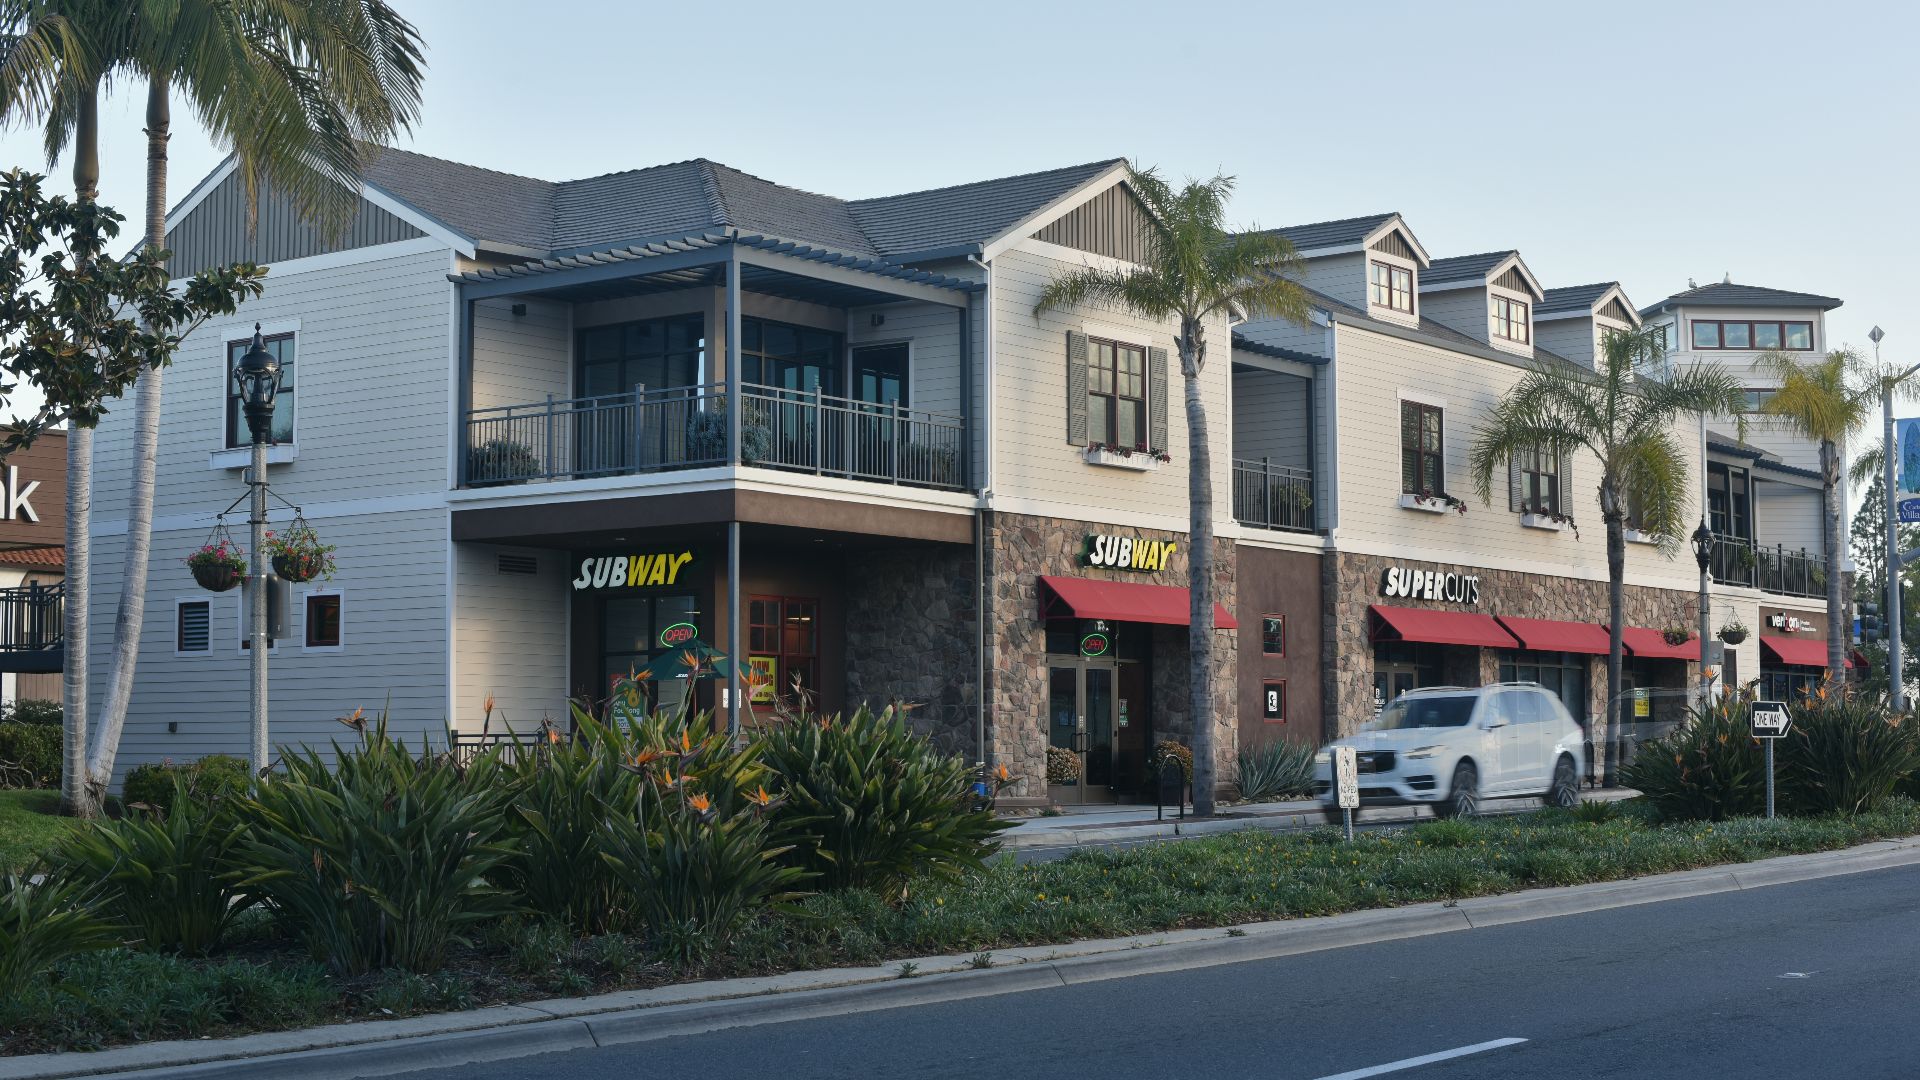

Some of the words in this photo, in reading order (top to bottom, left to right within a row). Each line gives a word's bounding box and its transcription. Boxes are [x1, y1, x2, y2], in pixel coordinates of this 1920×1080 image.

[1089, 535, 1177, 571] SUBWAY
[573, 550, 693, 591] SUBWAY
[1385, 567, 1479, 604] SUPERCUTS
[666, 629, 693, 641] OPEN
[1085, 639, 1105, 651] OPEN
[1756, 713, 1767, 726] ONE
[1769, 713, 1780, 726] WAY
